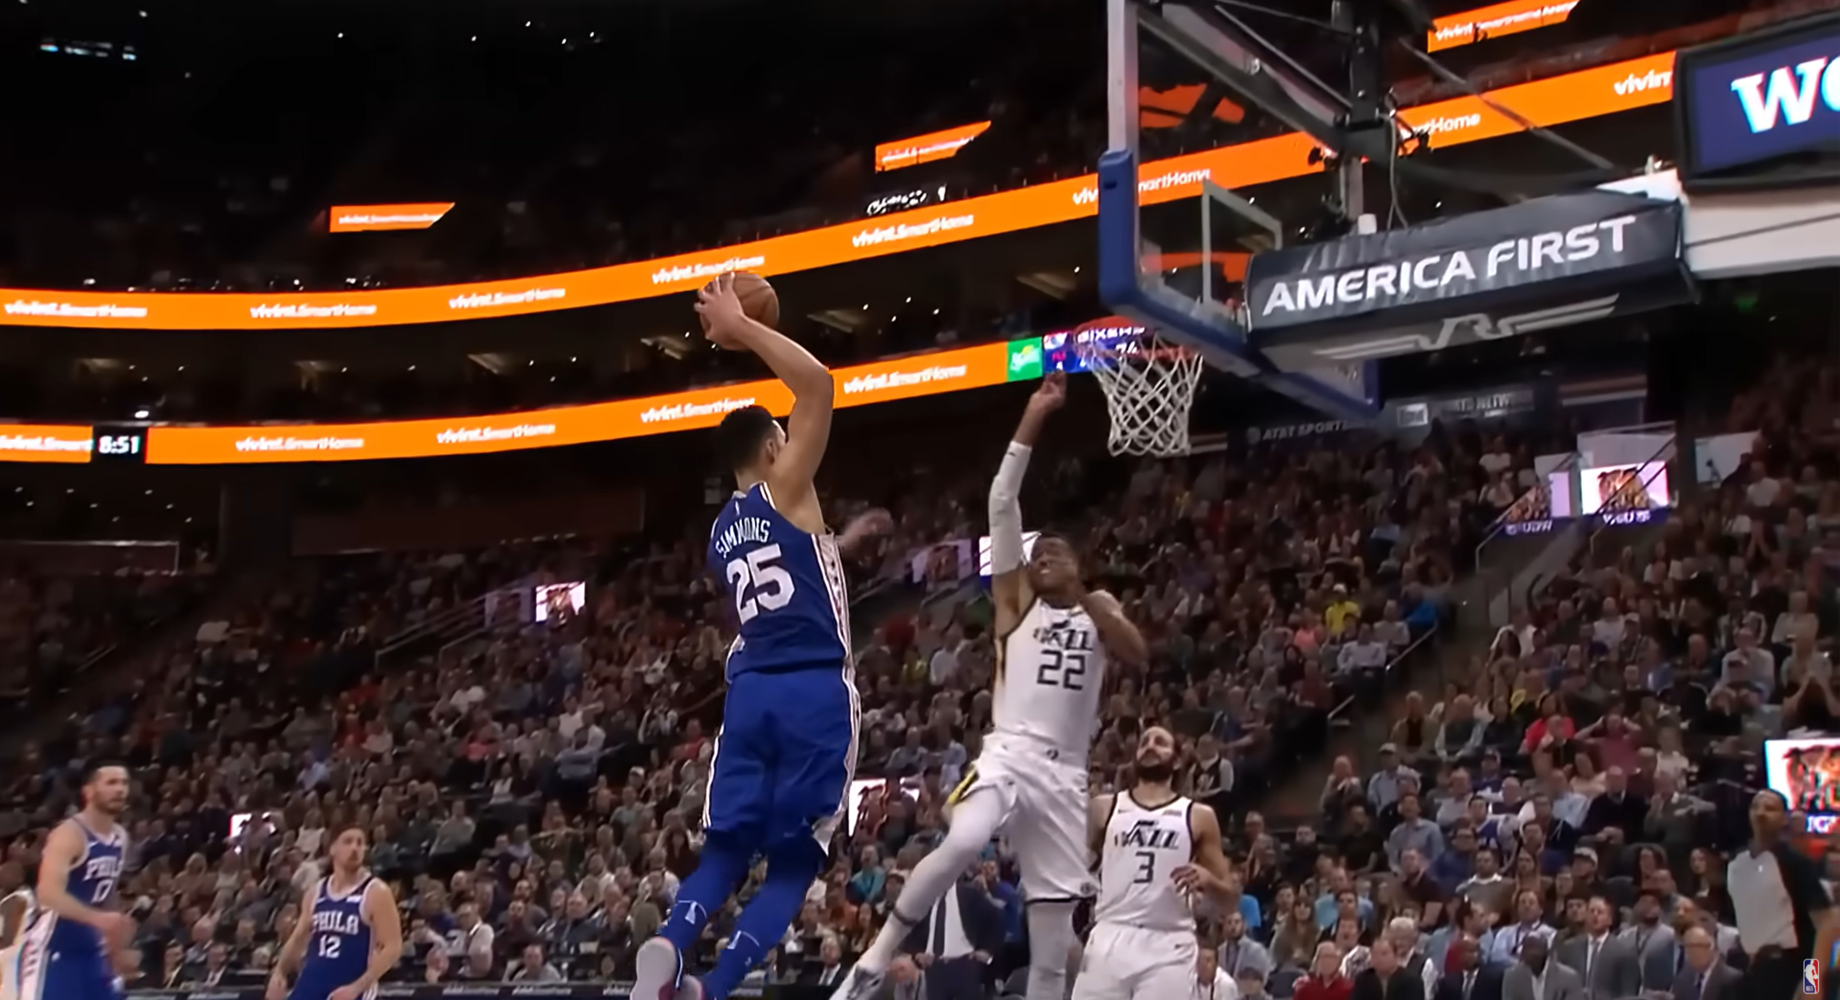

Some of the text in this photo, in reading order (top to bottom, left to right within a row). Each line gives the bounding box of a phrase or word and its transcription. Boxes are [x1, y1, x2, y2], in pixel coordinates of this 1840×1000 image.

[1262, 215, 1637, 316] AMERICA FIRST
[99, 435, 140, 454] 8:51
[715, 516, 771, 559] SIMMONS
[726, 543, 795, 625] 25
[1036, 649, 1086, 691] 22
[1133, 851, 1155, 884] 3
[318, 934, 342, 959] 12
